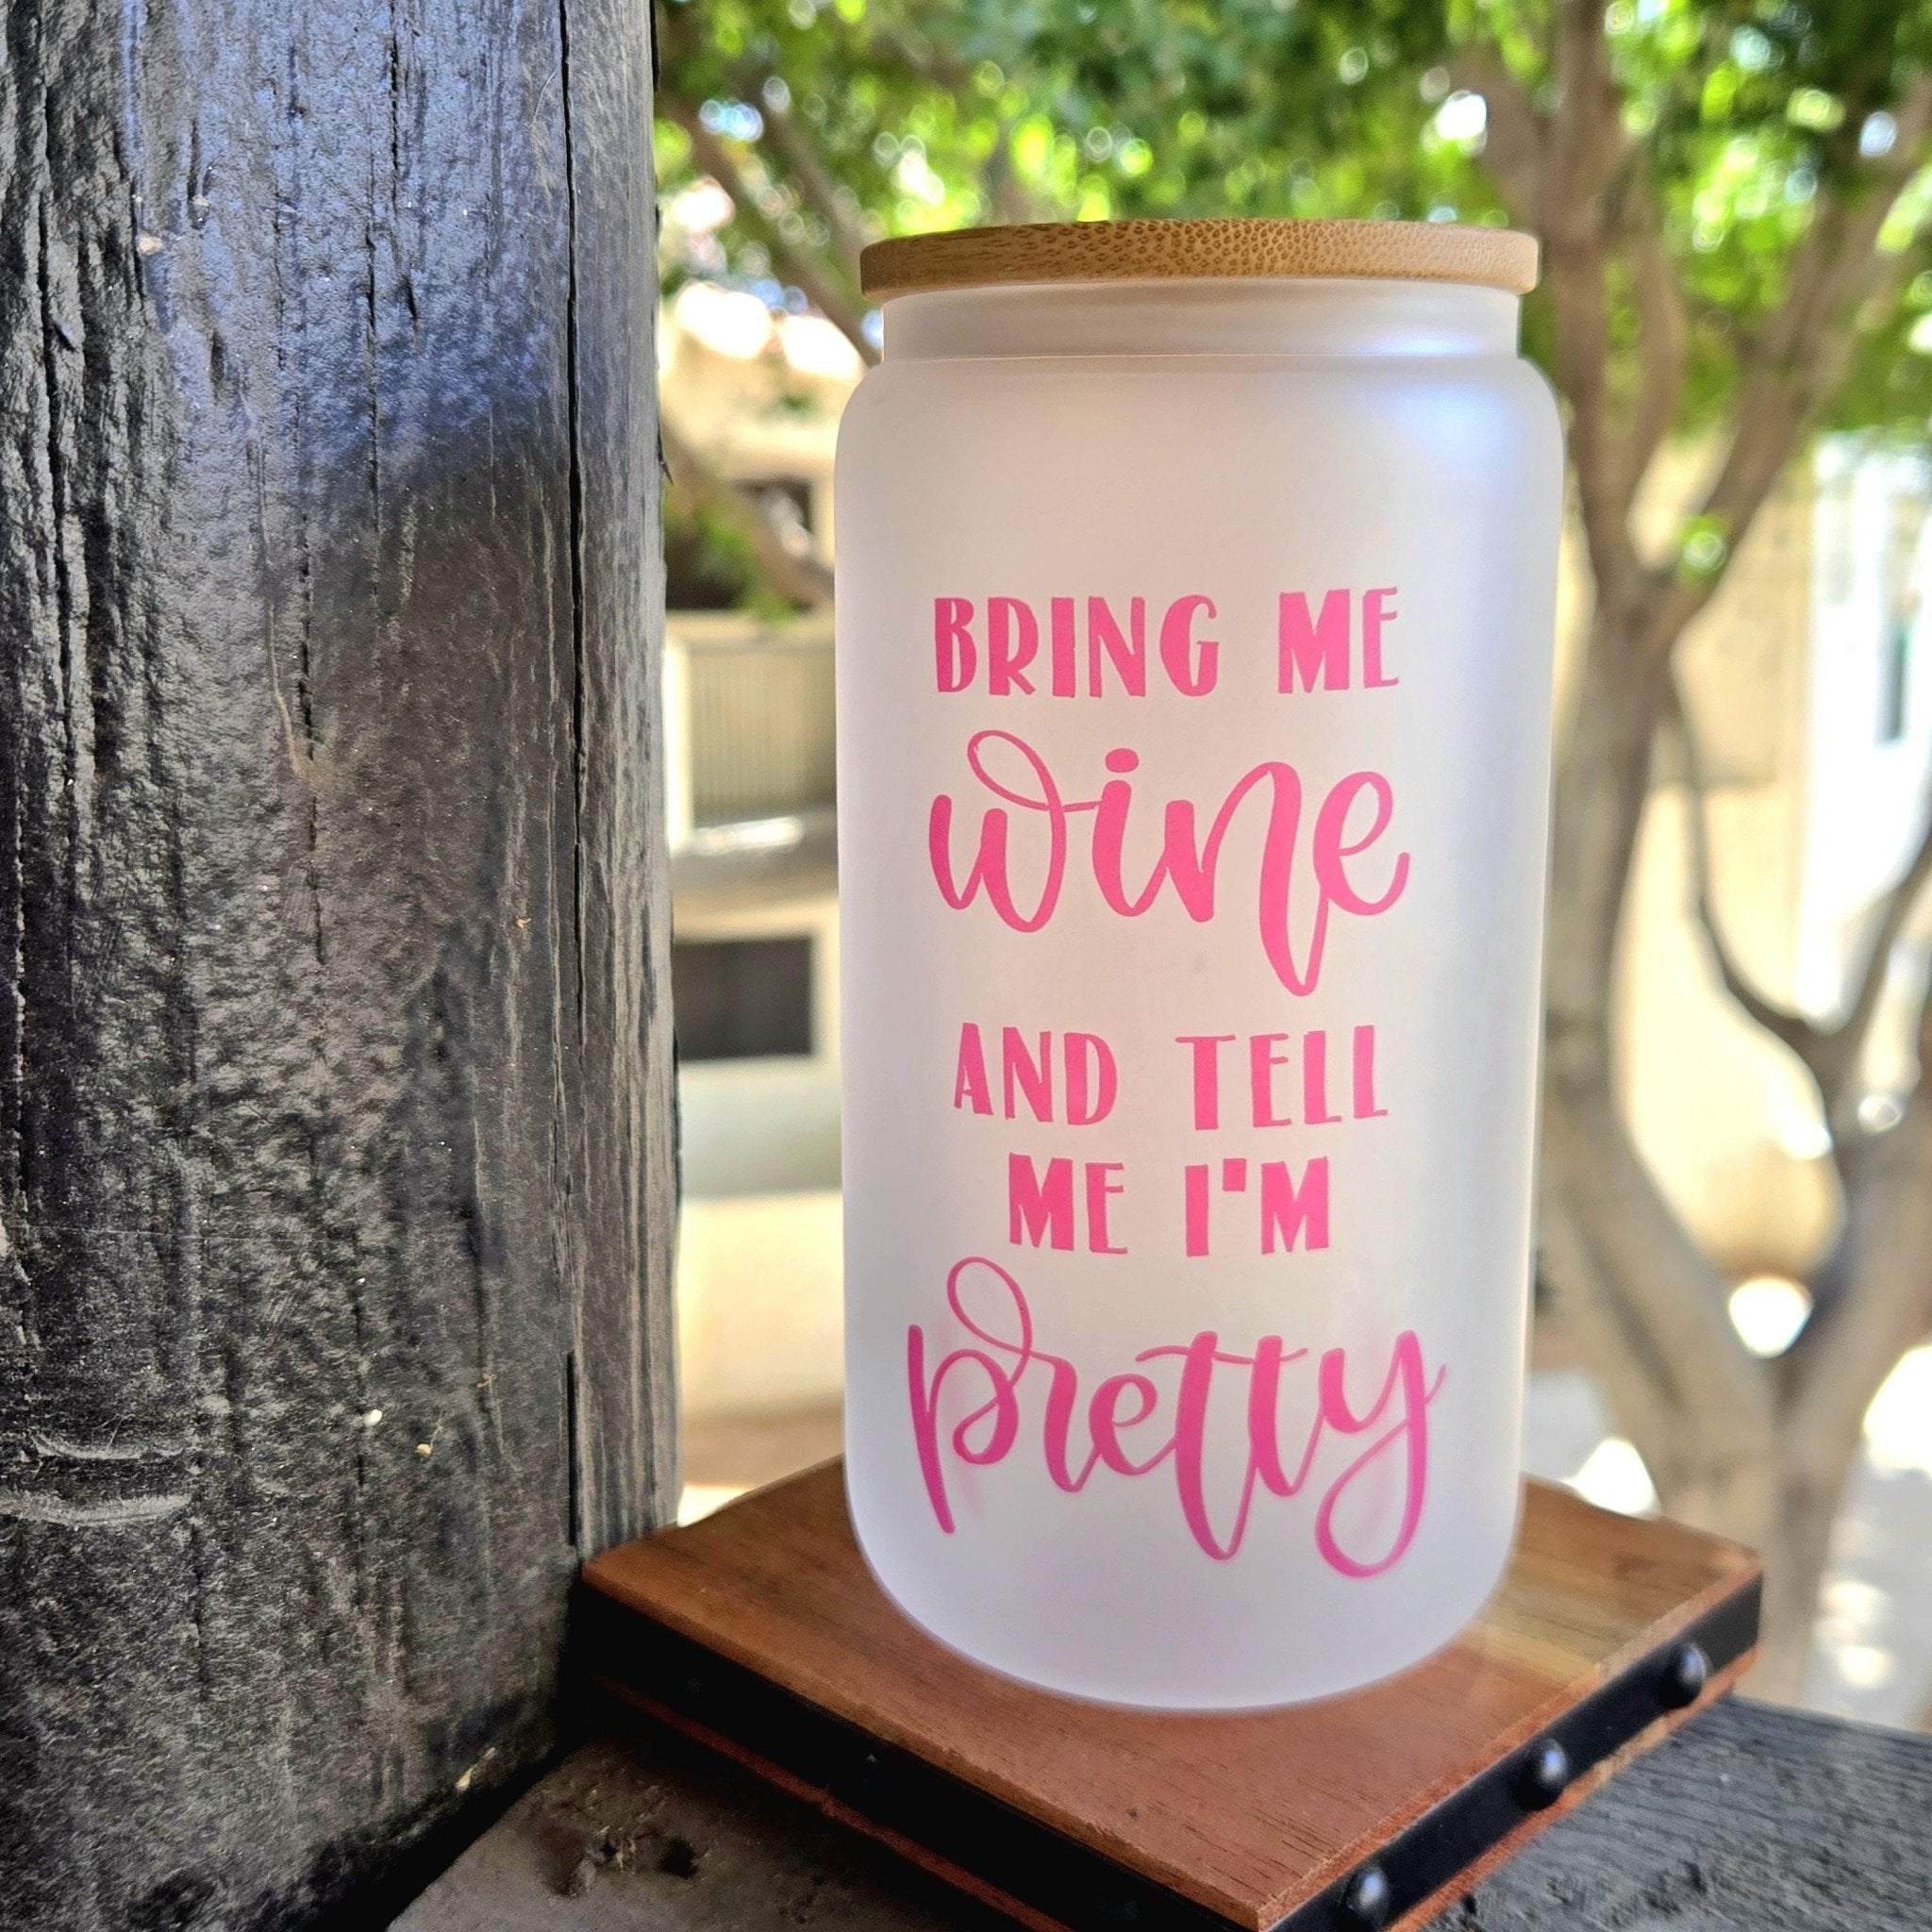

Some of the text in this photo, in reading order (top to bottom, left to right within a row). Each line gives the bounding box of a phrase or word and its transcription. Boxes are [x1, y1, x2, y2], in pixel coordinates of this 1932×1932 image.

[934, 587, 1399, 698] BRING ME
[928, 729, 1410, 997] wine
[953, 1022, 1389, 1131] AND TELL
[1008, 1152, 1330, 1258] ME I'M
[907, 1256, 1447, 1580] pretty
